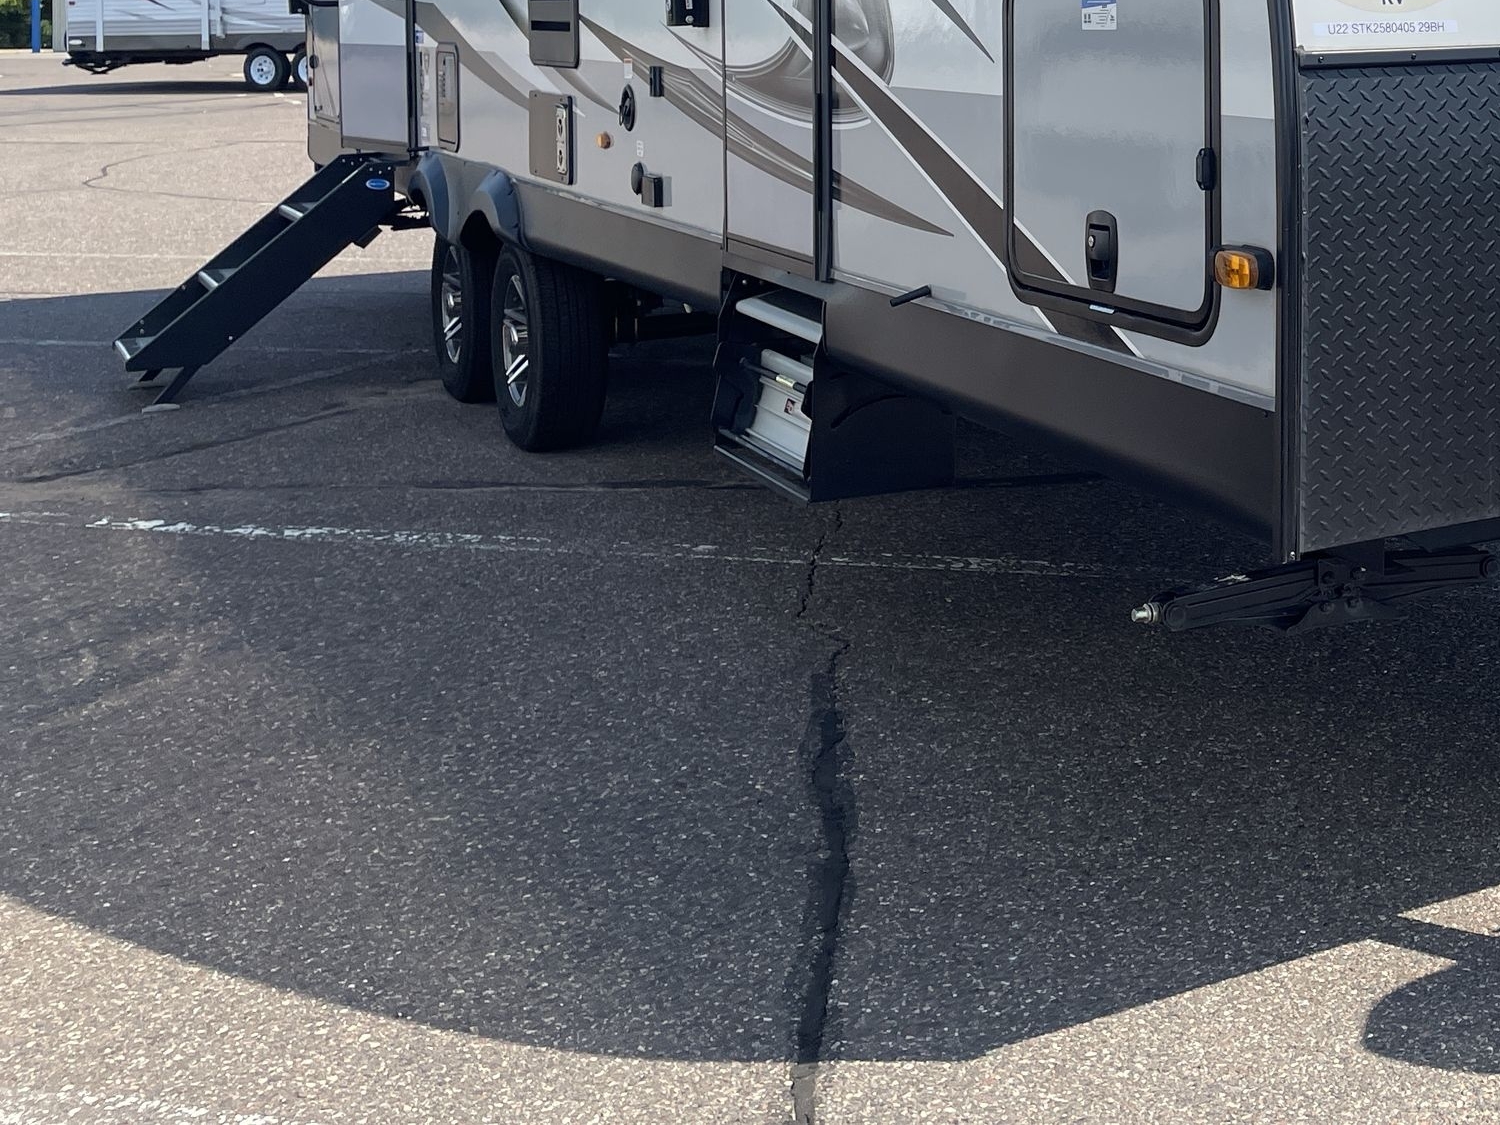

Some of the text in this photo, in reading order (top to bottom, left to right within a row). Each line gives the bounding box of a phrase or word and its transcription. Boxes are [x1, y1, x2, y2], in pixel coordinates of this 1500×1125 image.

[1328, 21, 1445, 35] U22 STK2580405 29BH
